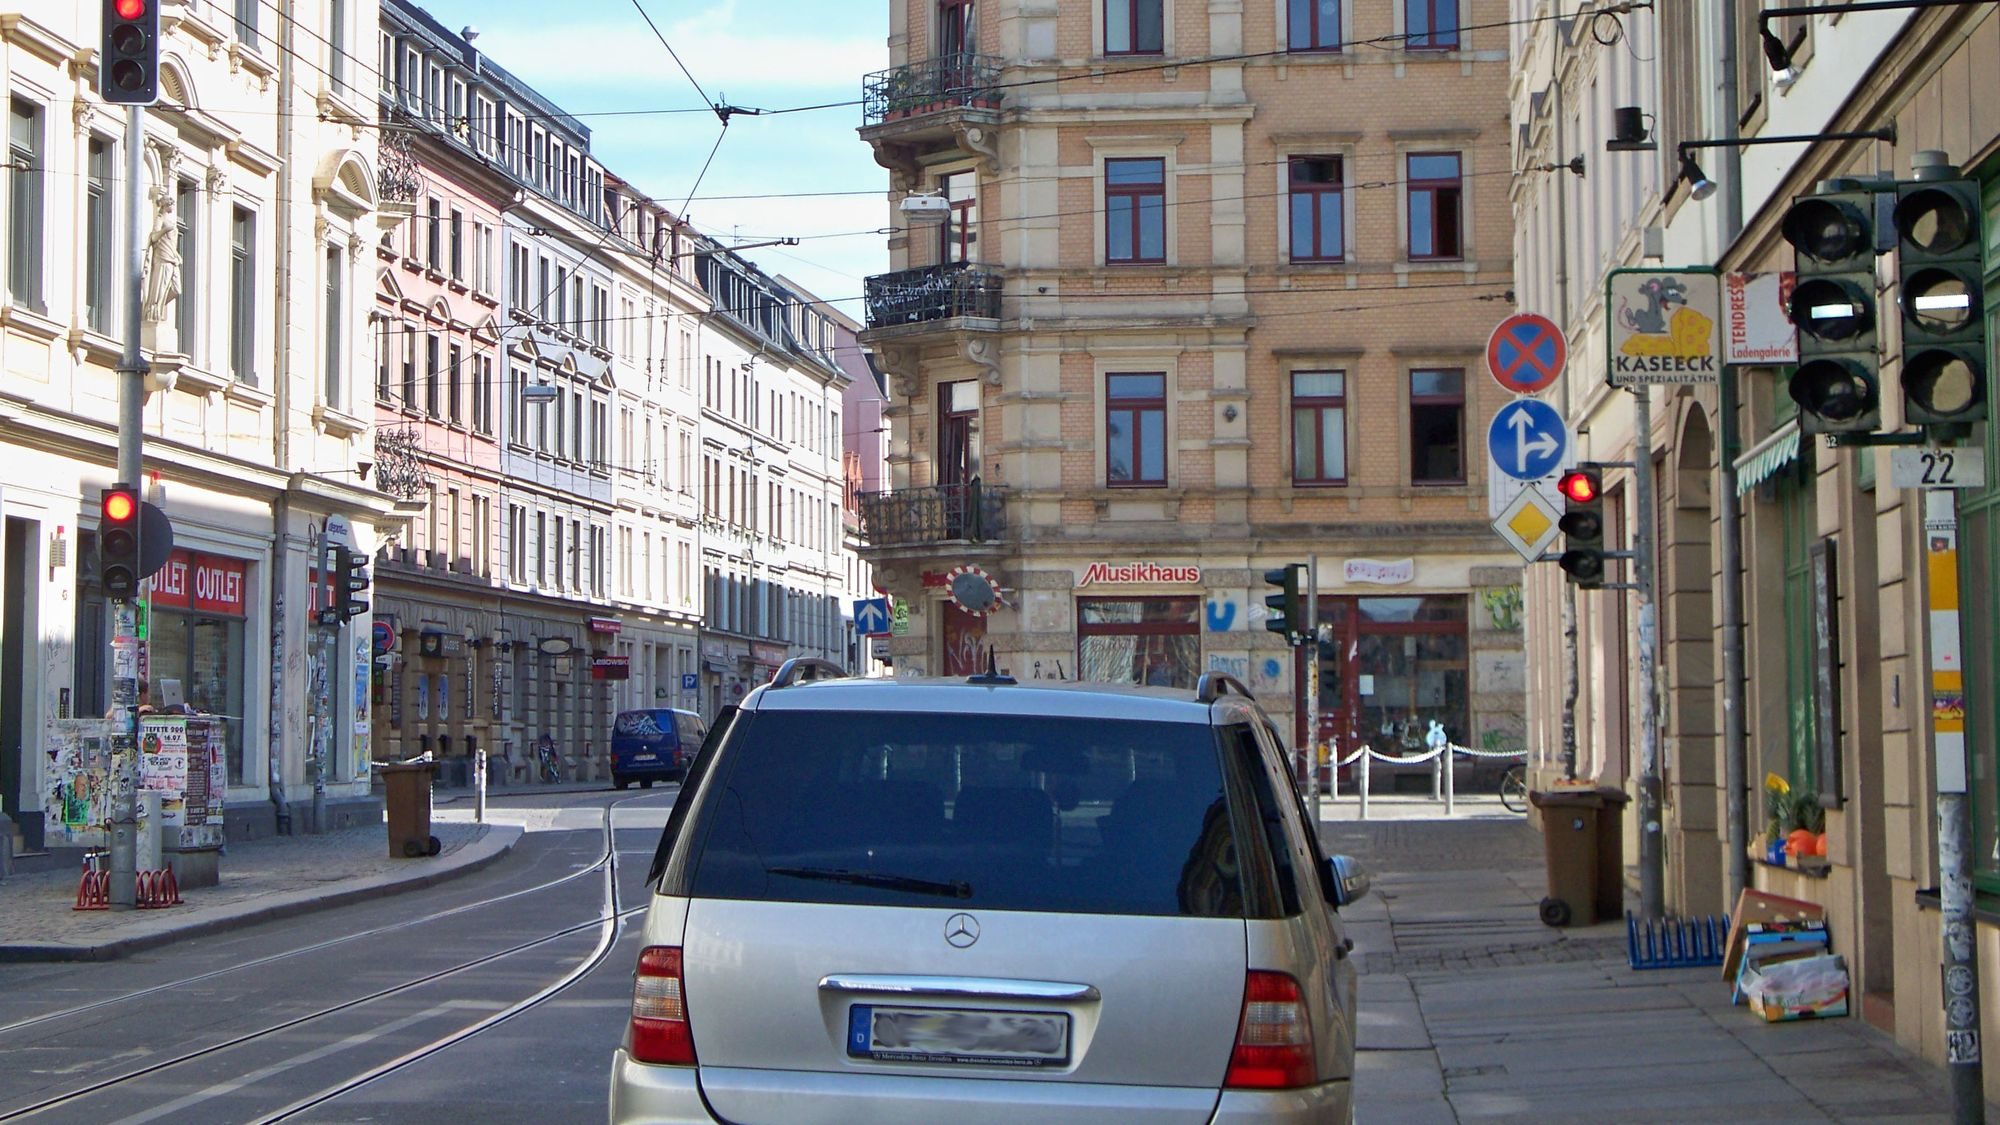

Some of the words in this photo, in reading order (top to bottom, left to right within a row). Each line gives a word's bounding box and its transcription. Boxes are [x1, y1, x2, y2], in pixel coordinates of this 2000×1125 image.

[1616, 352, 1714, 372] KÄSEECK
[1732, 345, 1790, 360] Ladengalerie
[1638, 374, 1716, 383] SPEZIALITÄTEN
[1921, 454, 1954, 484] 22
[196, 566, 241, 603] OUTLET
[1080, 563, 1199, 587] Musikhaus
[856, 1033, 865, 1043] D
